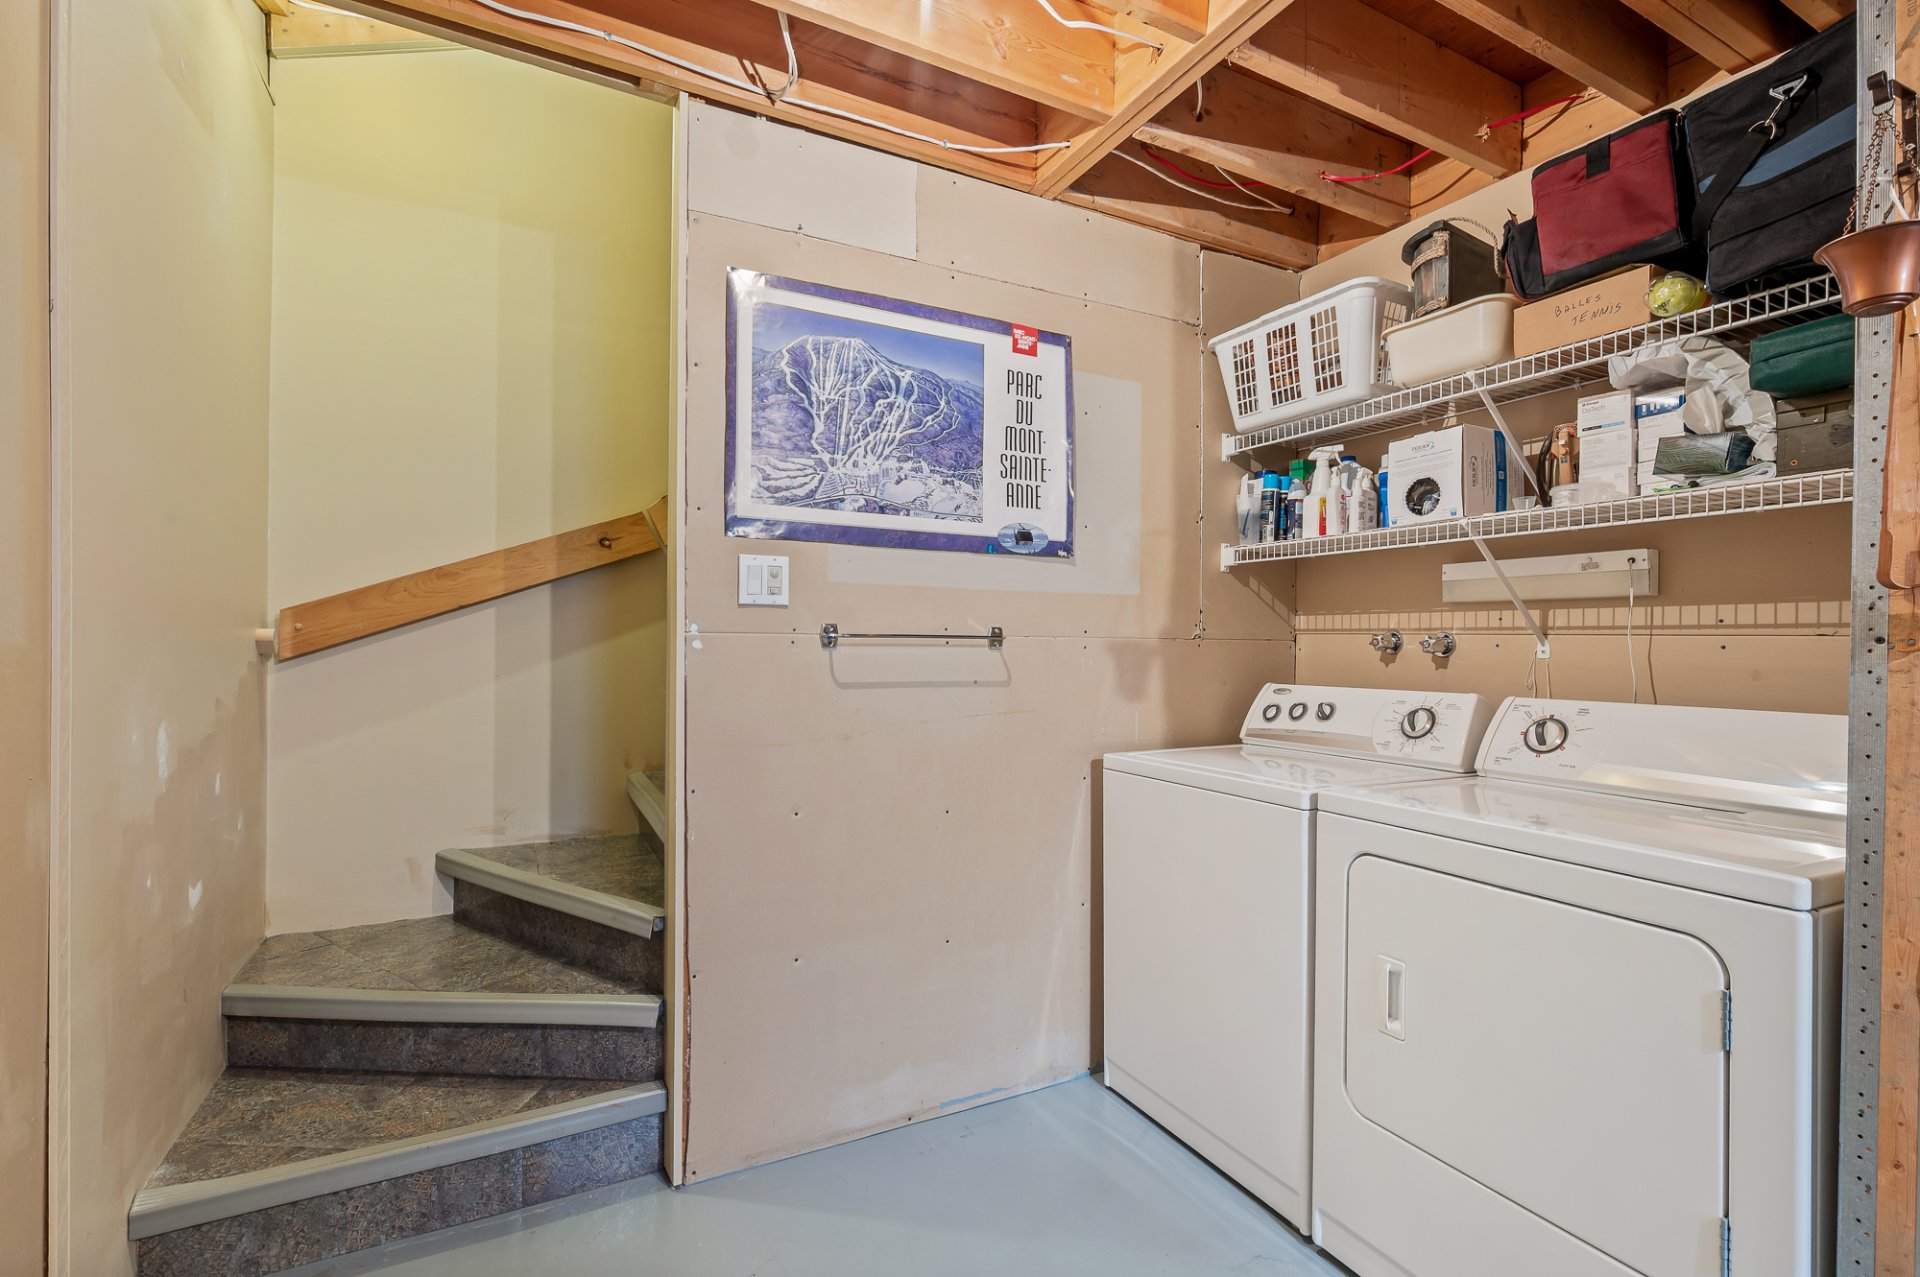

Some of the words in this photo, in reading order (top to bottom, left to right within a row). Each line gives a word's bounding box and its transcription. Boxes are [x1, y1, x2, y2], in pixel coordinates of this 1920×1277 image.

[1554, 293, 1601, 318] BALLES
[1571, 302, 1622, 326] TENNIS
[1007, 369, 1042, 399] PARC
[1016, 399, 1033, 425] DU
[1005, 425, 1046, 454] MONT-
[1000, 453, 1051, 482] SAINTE-
[1006, 482, 1041, 510] ANNE
